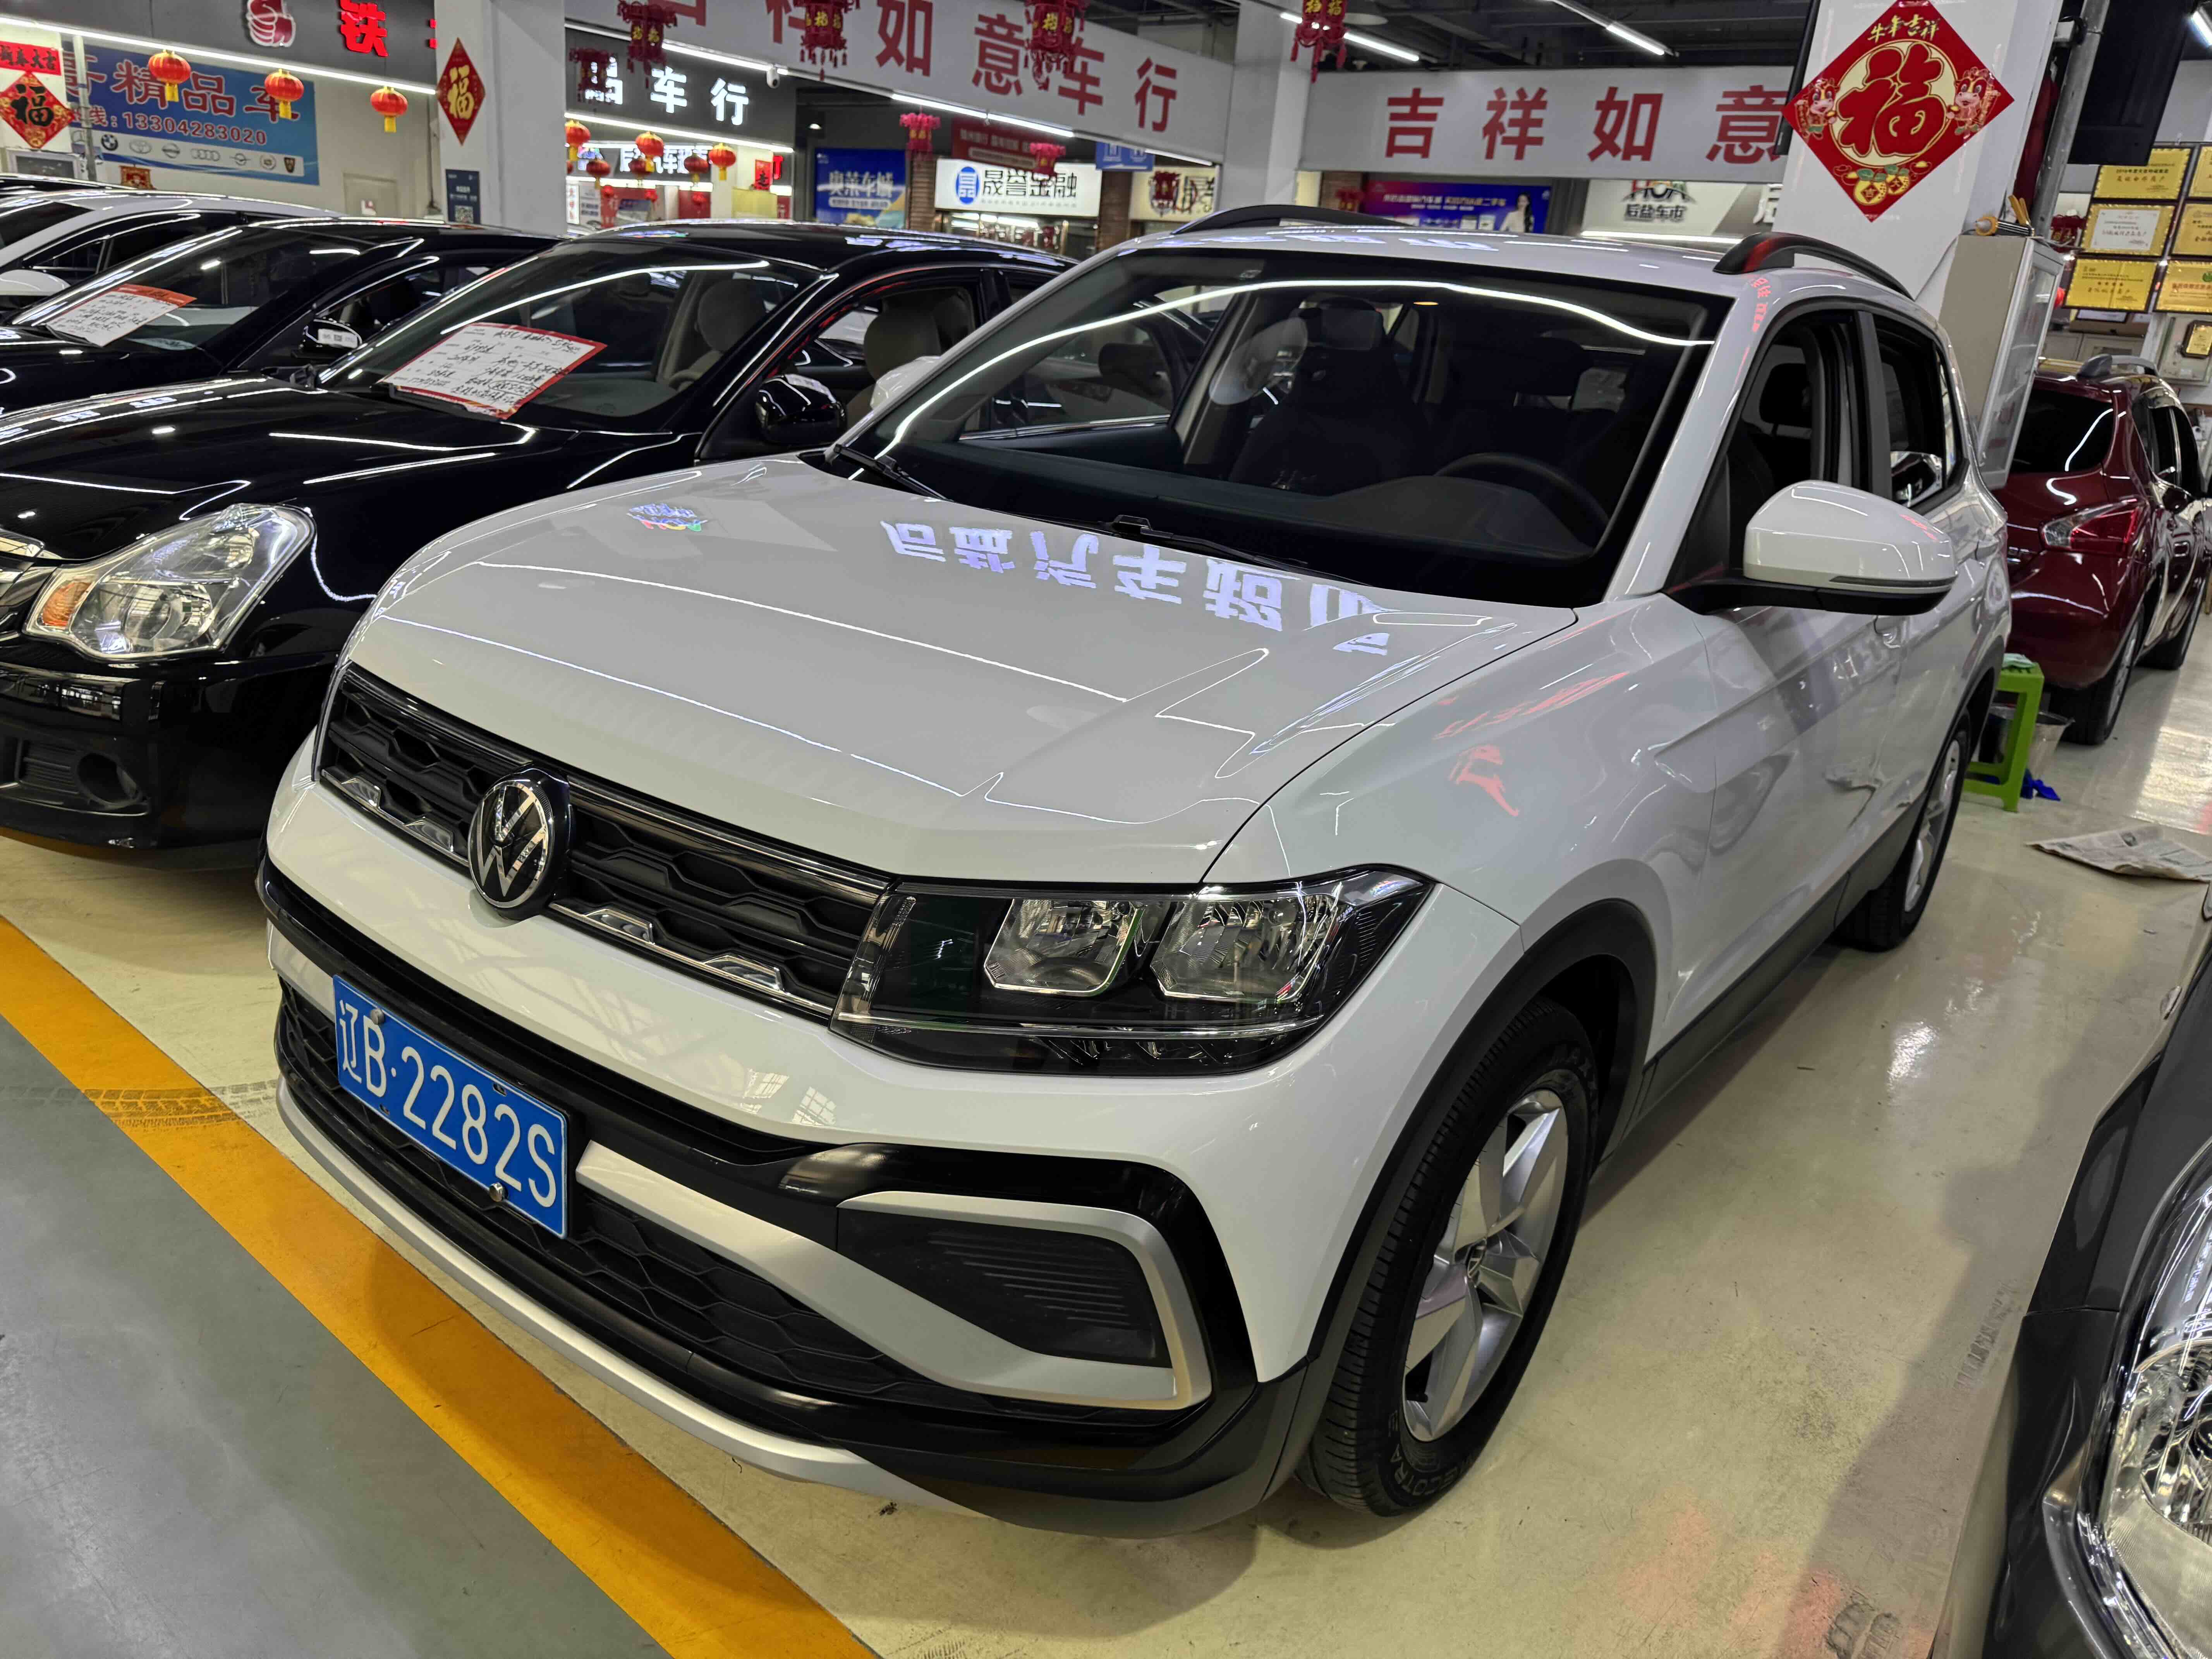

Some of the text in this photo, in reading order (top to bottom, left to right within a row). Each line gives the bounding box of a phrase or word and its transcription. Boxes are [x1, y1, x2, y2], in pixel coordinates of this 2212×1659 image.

[663, 0, 1177, 132] 如意车行
[1867, 14, 1940, 43] 牛年吉祥
[10, 82, 55, 127] 福
[448, 64, 475, 120] 福
[1385, 85, 1788, 164] 吉祥如意
[1836, 42, 1944, 157] 福
[339, 1000, 556, 1208] 辽B·2282S
